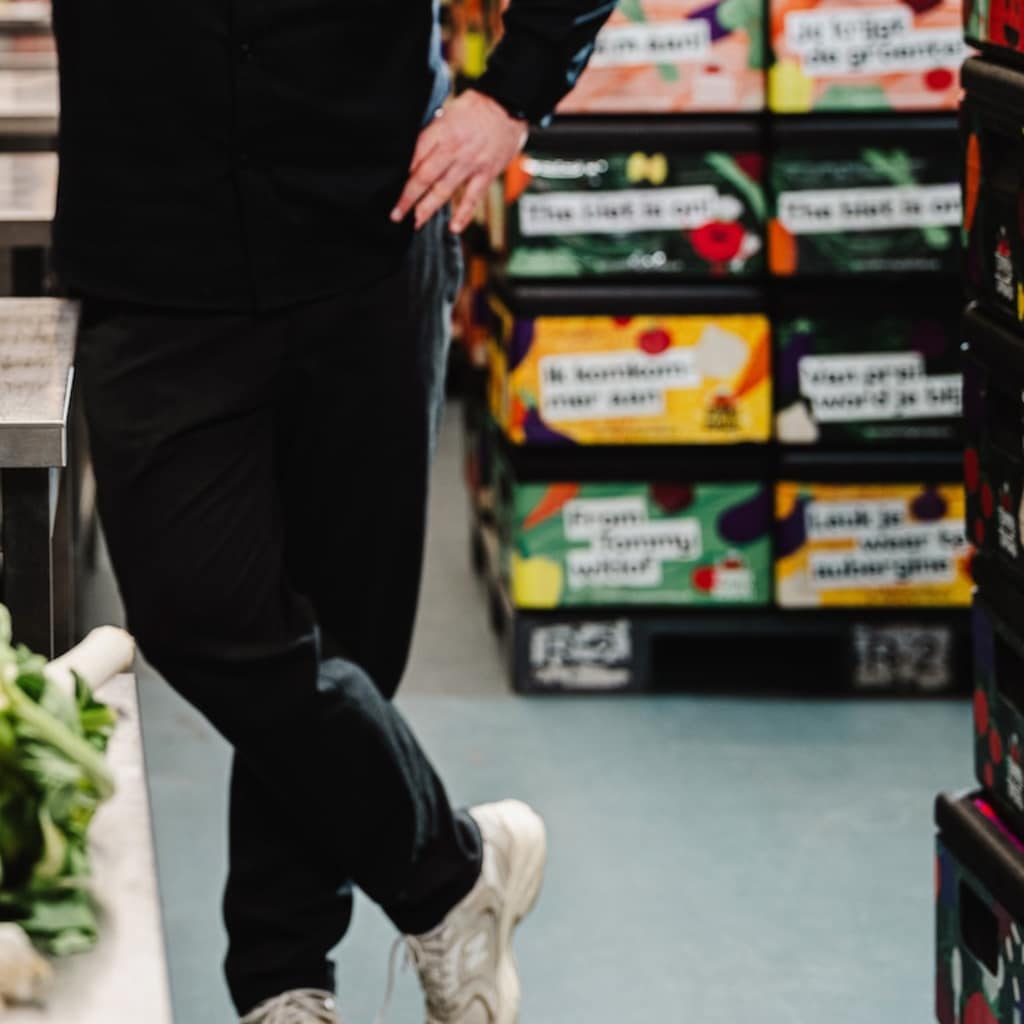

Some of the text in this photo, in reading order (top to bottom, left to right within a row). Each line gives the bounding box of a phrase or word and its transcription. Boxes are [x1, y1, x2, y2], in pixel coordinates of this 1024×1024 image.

[528, 201, 574, 223] The
[786, 200, 833, 222] The
[811, 508, 871, 529] Leuk
[601, 532, 694, 556] Tommy
[814, 554, 951, 583] aubergine
